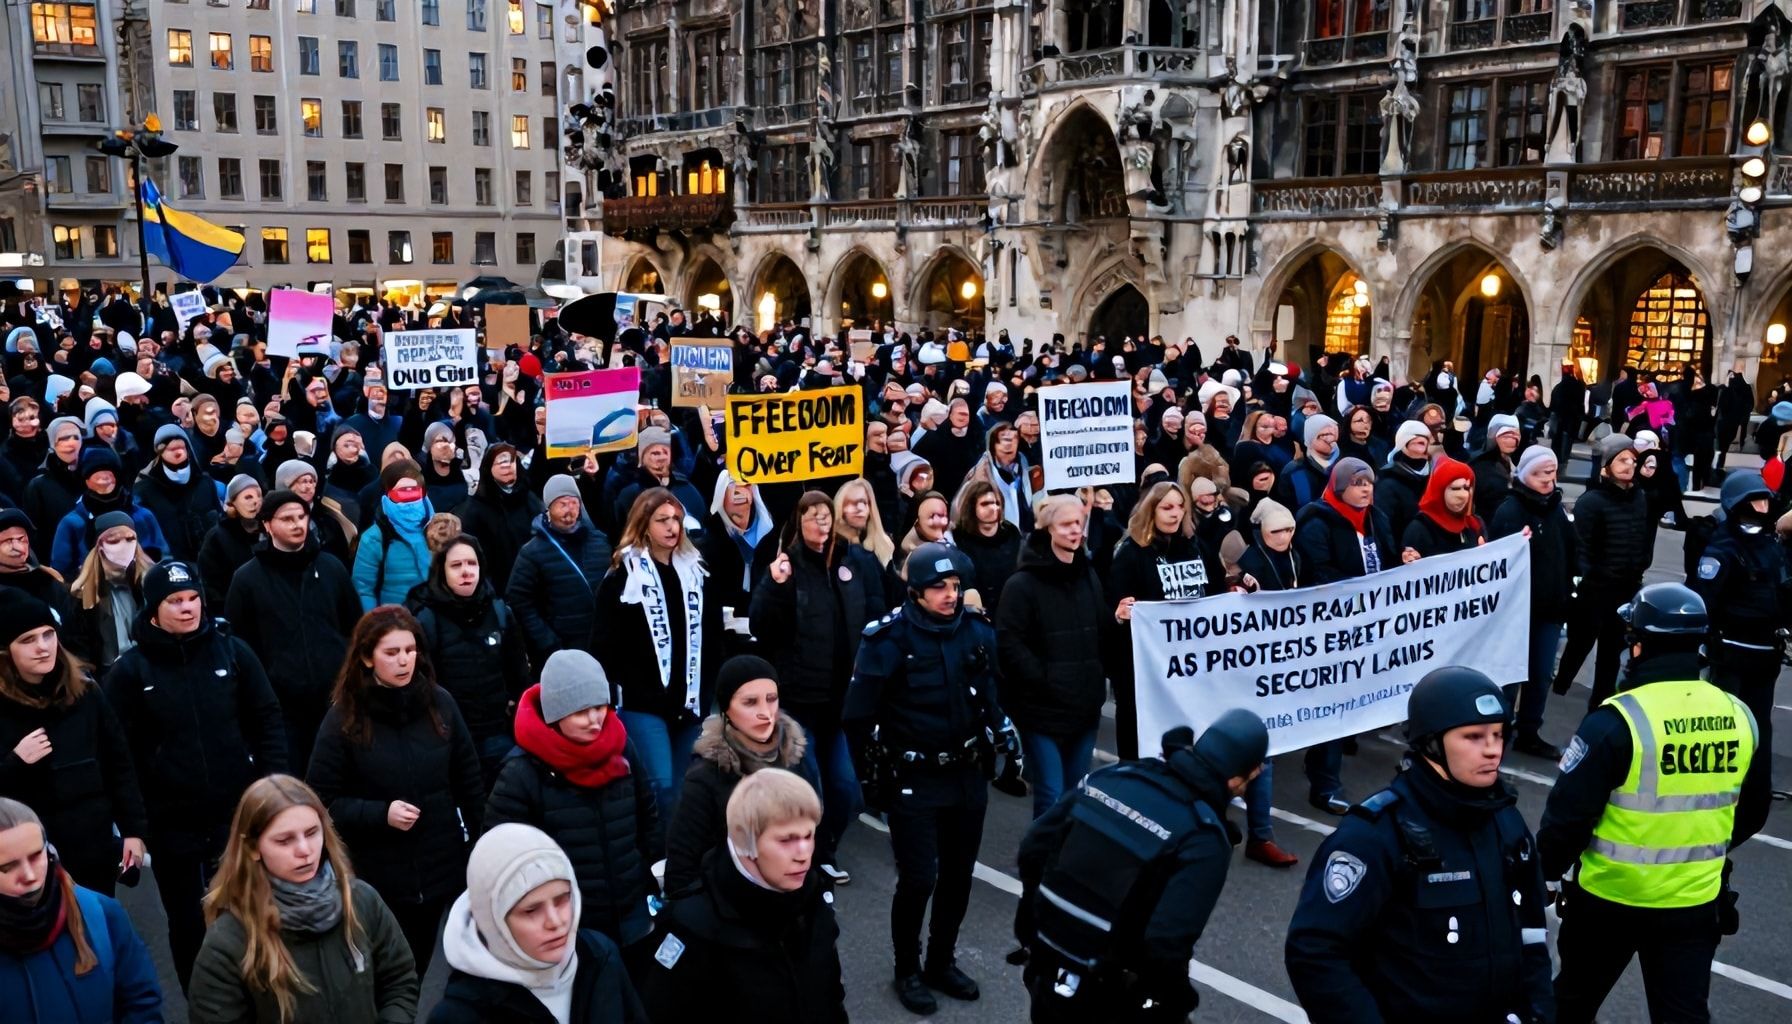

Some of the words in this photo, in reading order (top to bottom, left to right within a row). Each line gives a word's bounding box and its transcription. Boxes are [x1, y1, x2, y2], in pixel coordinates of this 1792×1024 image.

[737, 446, 801, 483] Over
[1159, 604, 1307, 643] THOUSANDS
[1166, 652, 1199, 679] AS
[1394, 605, 1449, 637] OVER
